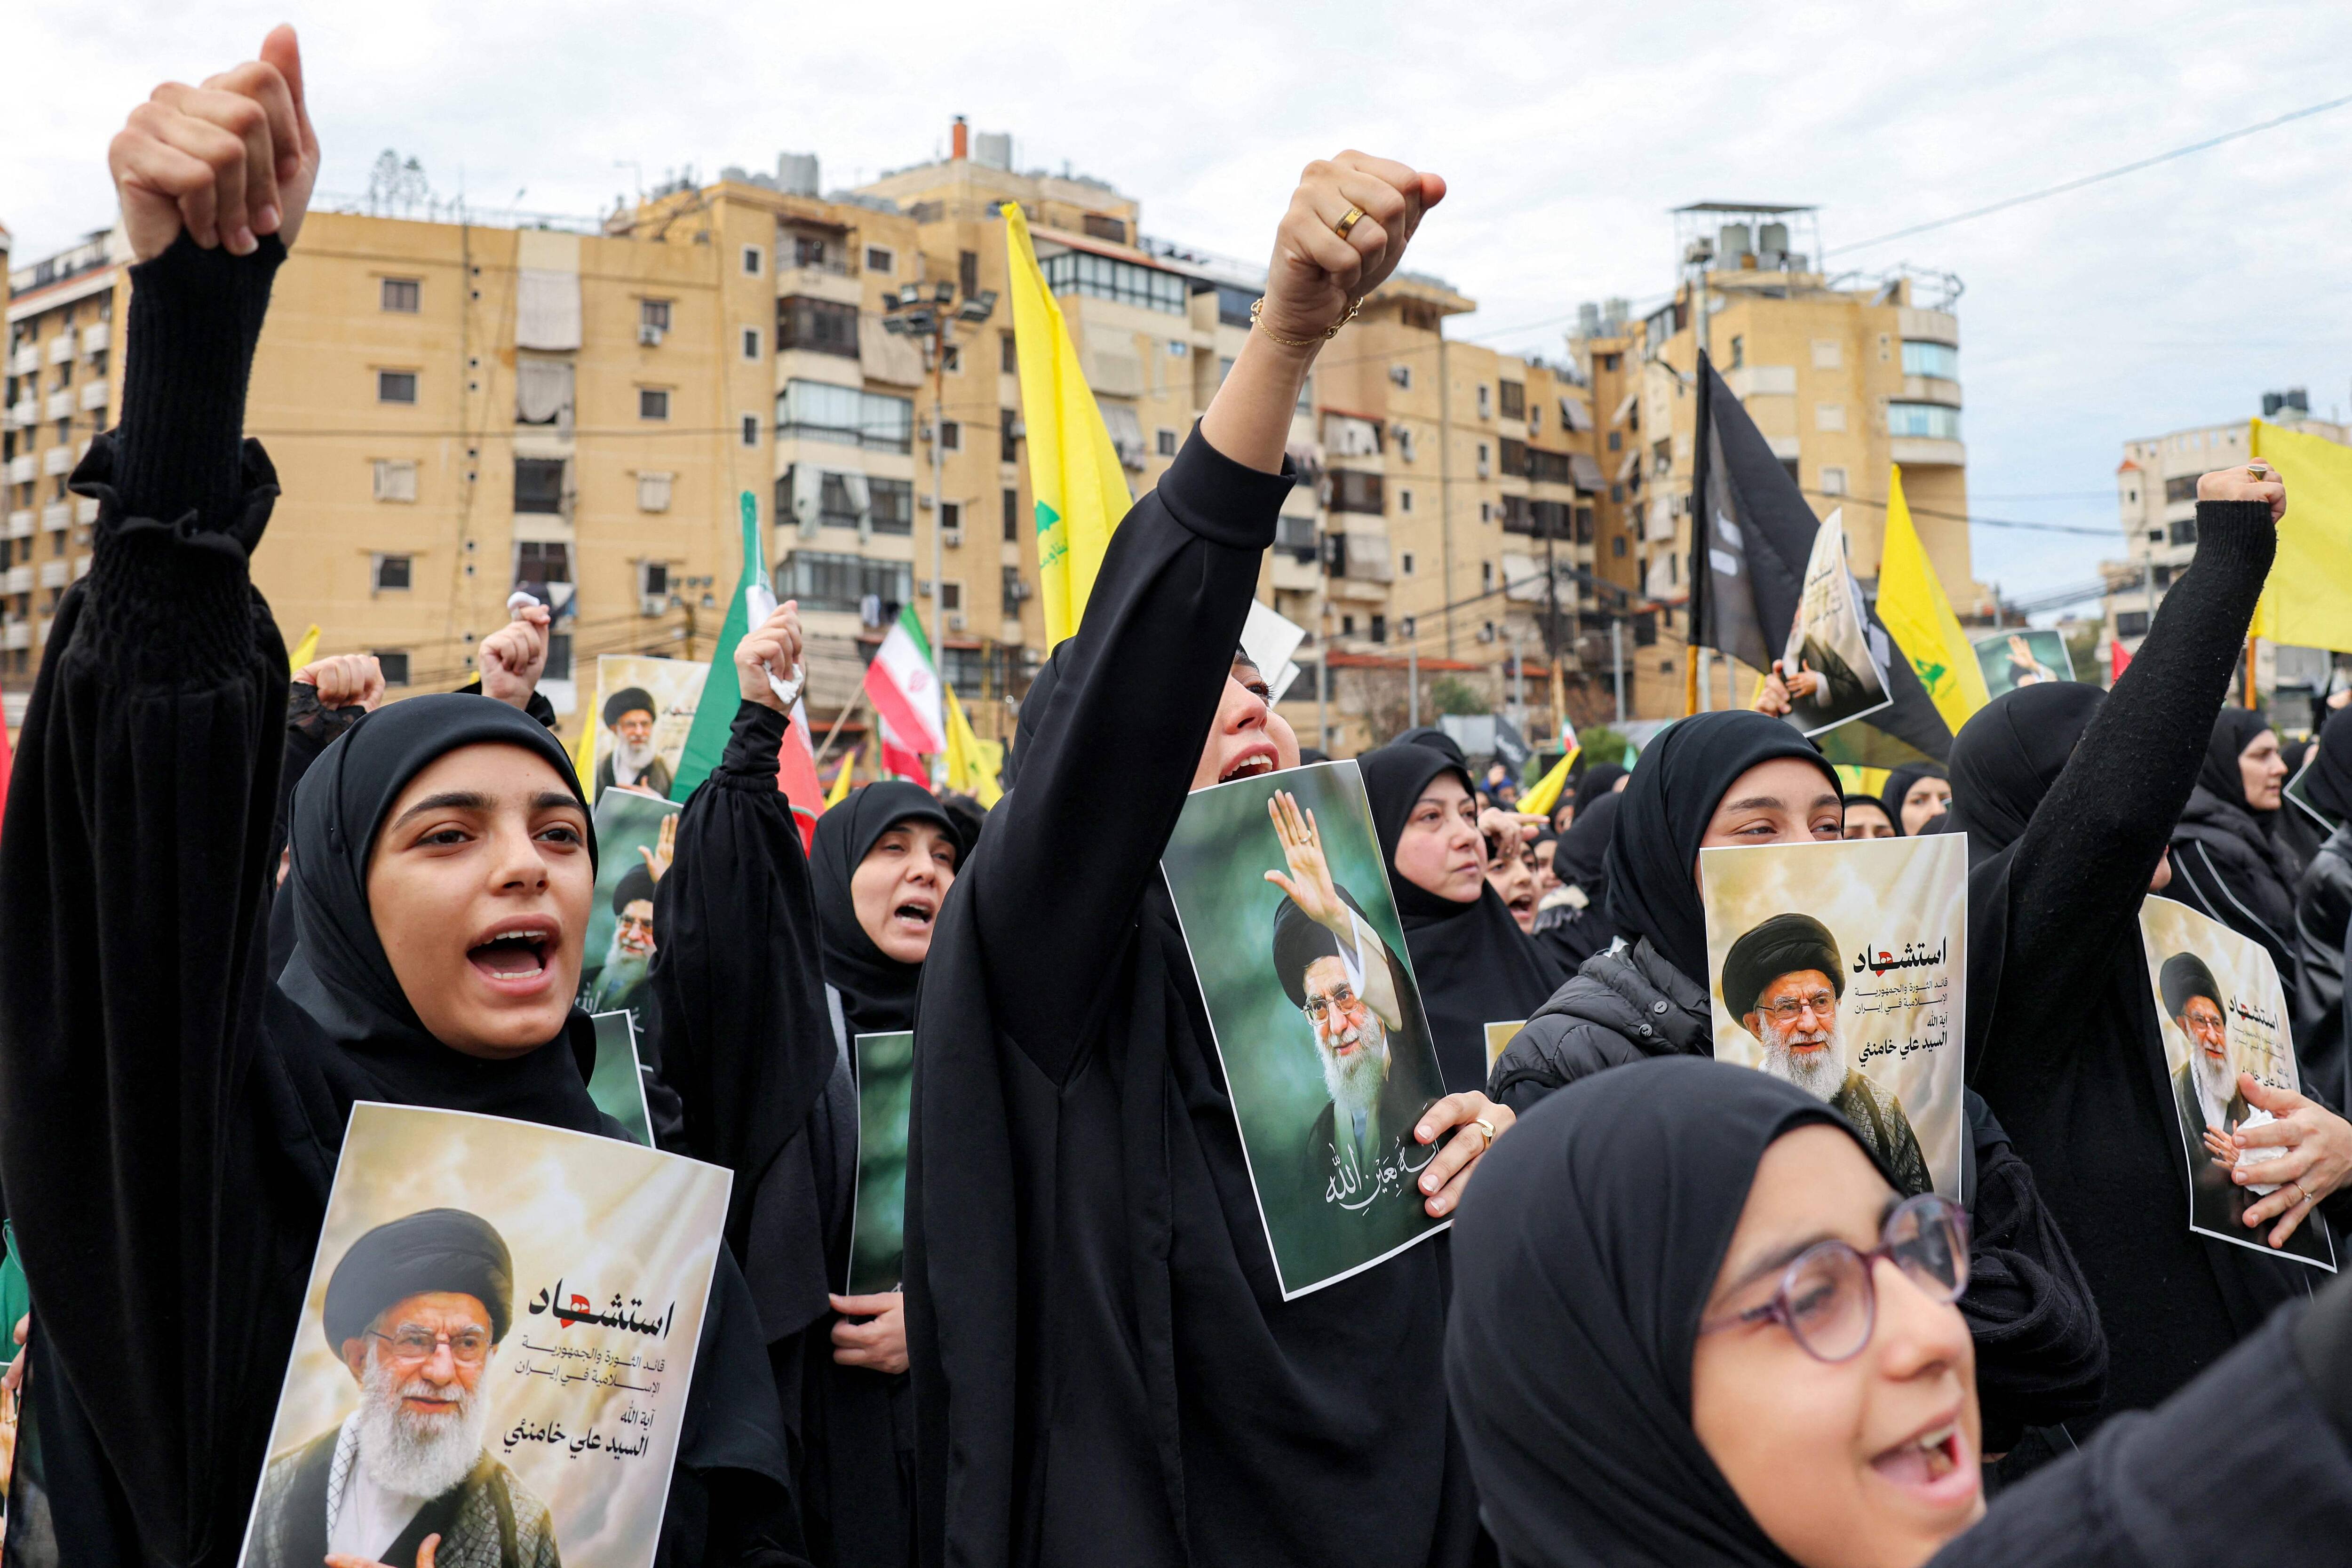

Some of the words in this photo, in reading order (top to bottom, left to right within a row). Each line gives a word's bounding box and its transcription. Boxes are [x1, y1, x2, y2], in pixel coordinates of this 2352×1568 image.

[1853, 936, 1946, 977] استشهاد
[1855, 984, 1907, 997] والجمهورية
[1909, 981, 1932, 993] الثورة
[1934, 978, 1948, 988] قائد
[1855, 1001, 1883, 1014] إيران
[1884, 1000, 1902, 1015] في
[1904, 994, 1948, 1009] الإسلامية
[1927, 1011, 1938, 1027] الله
[1939, 1011, 1948, 1026] آية
[1900, 1036, 1919, 1060] علي
[1922, 1031, 1947, 1053] السيد
[1859, 1039, 1897, 1067] خامنئي
[529, 1278, 675, 1340] استشهاد
[522, 1335, 602, 1364] والجمهورية
[605, 1349, 641, 1369] الثورة
[515, 1360, 559, 1381] إيران
[560, 1367, 588, 1386] في
[643, 1359, 665, 1373] قائد
[591, 1370, 661, 1398] الإسلامية
[620, 1400, 637, 1425] الله
[640, 1409, 656, 1431] آية
[504, 1418, 565, 1454] خامنئي
[569, 1427, 601, 1459] علي
[605, 1434, 650, 1460] السيد
